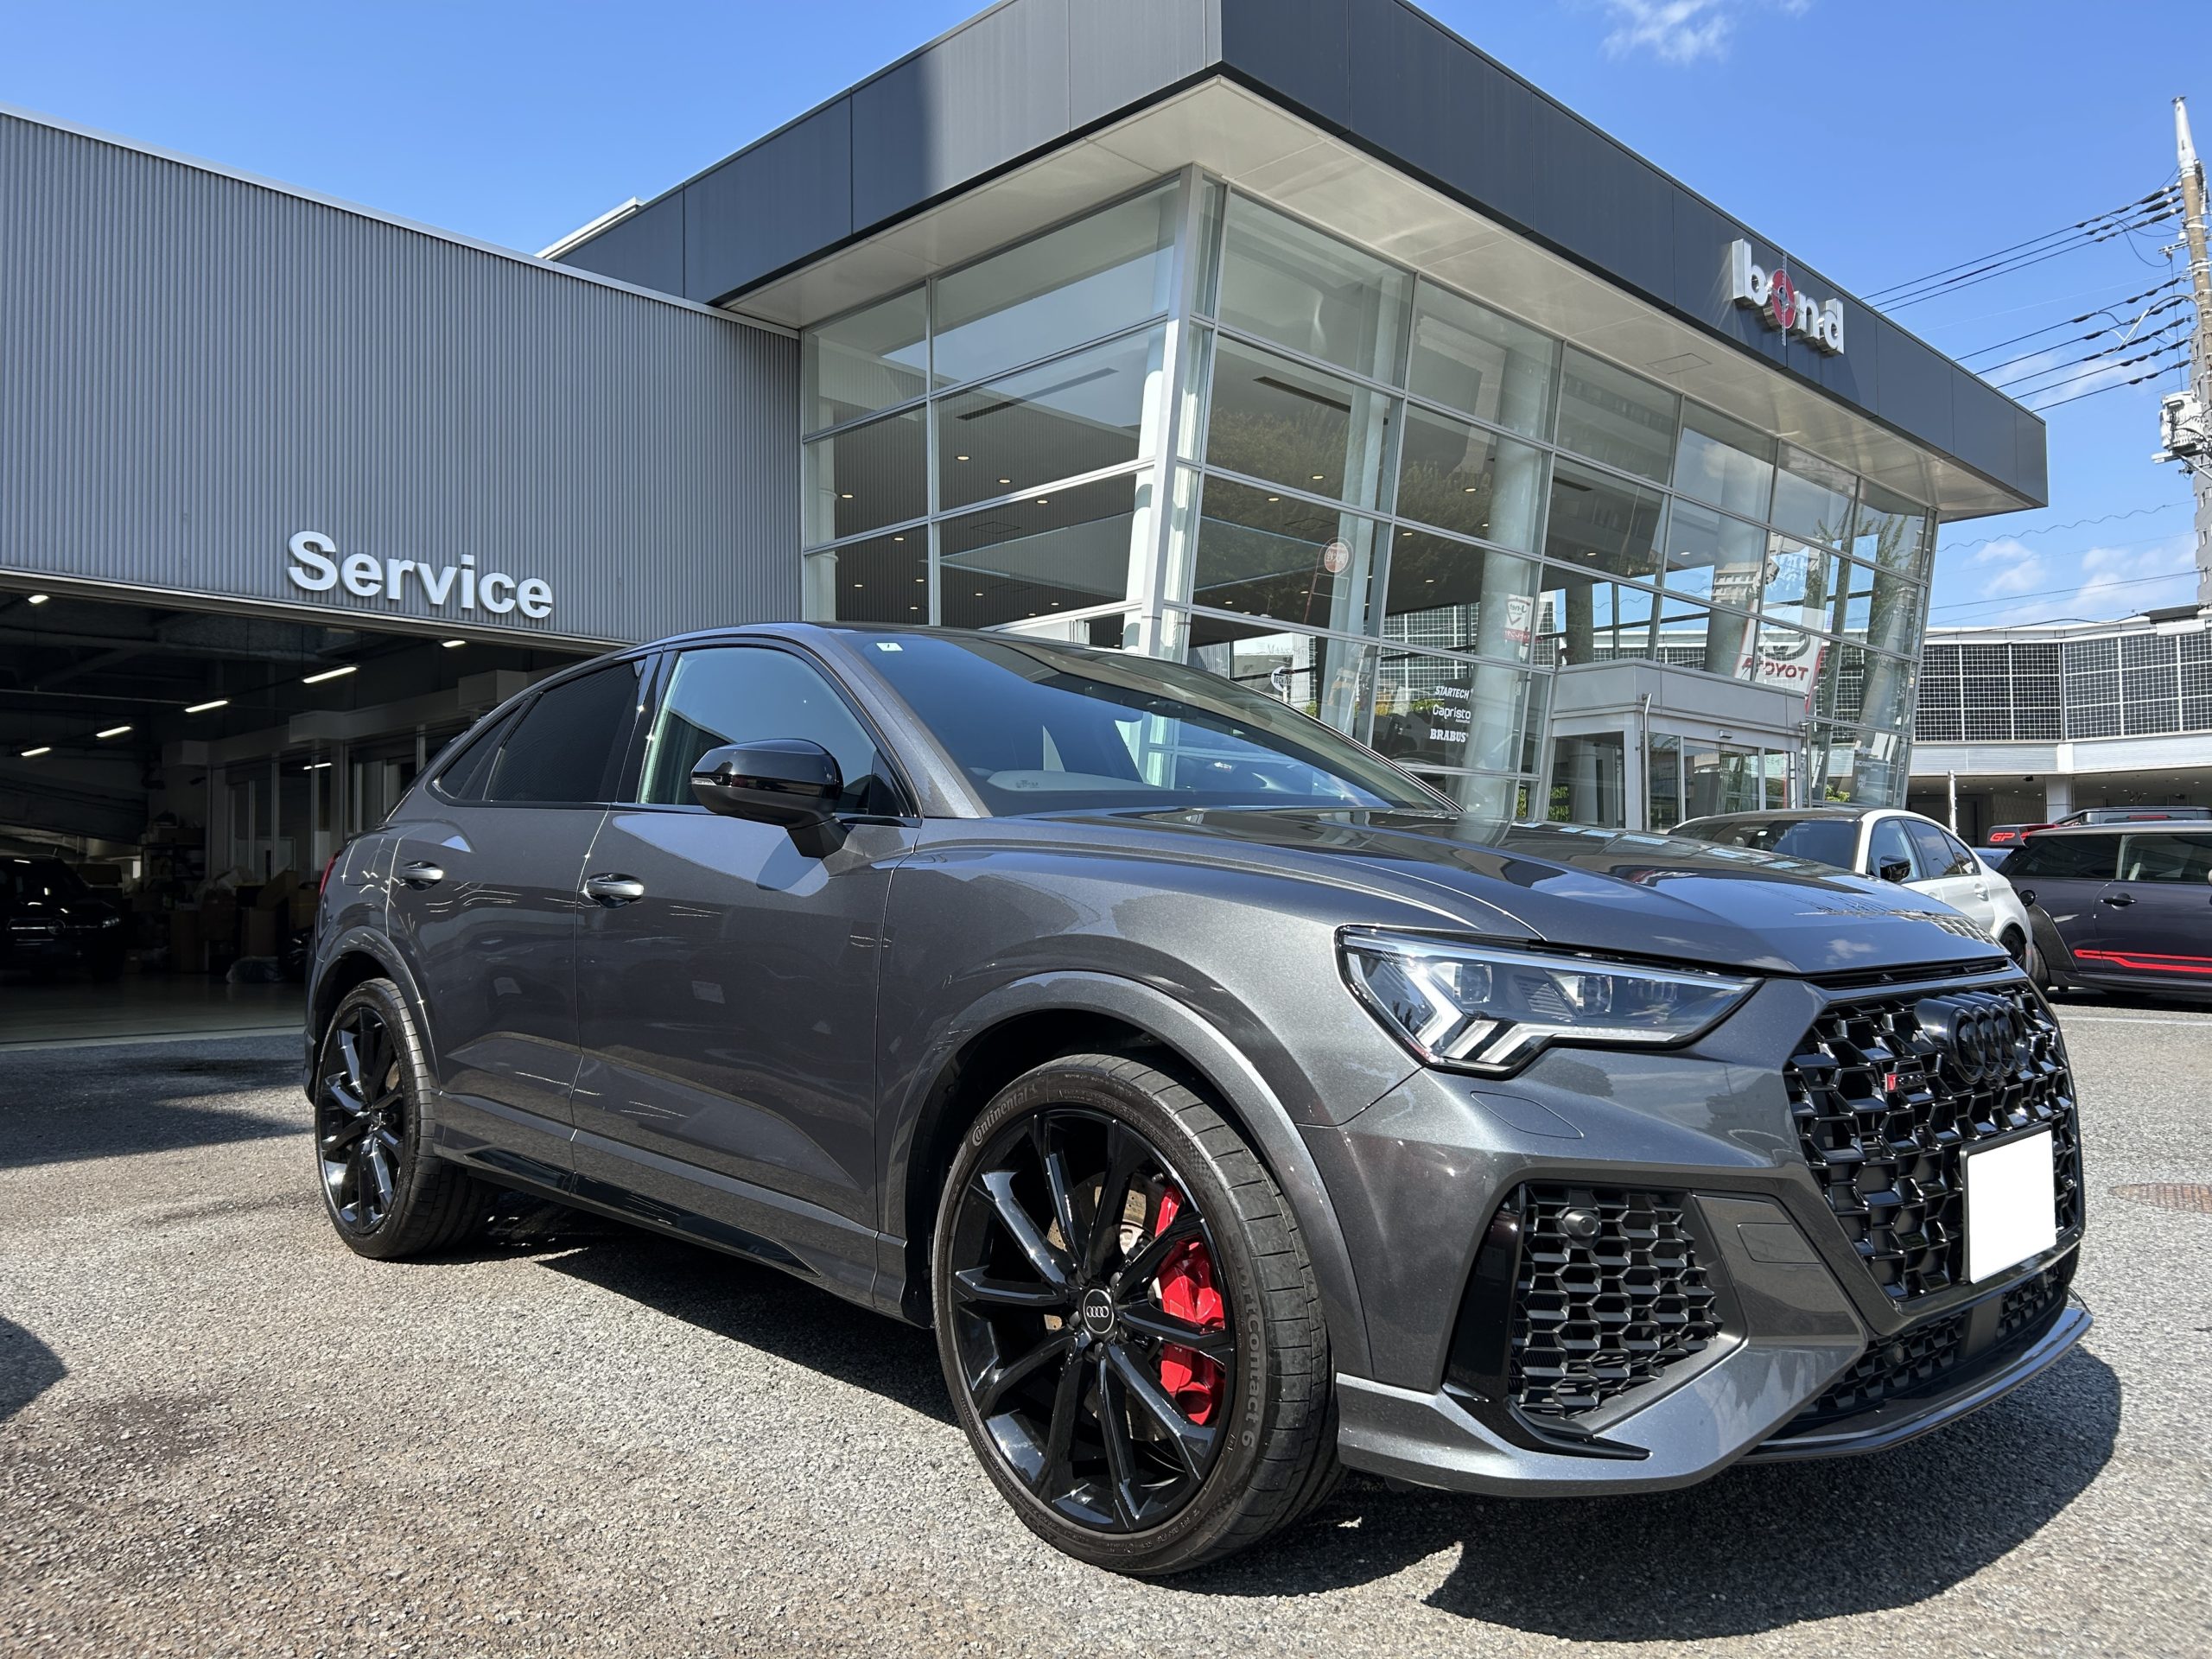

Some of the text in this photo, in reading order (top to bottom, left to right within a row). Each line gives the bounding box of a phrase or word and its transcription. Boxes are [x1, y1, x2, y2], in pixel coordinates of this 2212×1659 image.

[1732, 238, 1845, 355] bond
[288, 531, 553, 619] Service
[1434, 685, 1470, 700] STARTECH
[1433, 704, 1471, 720] Capristo
[1429, 728, 1466, 743] BRABUS
[1989, 832, 2016, 842] GP
[971, 1086, 1028, 1147] Continental
